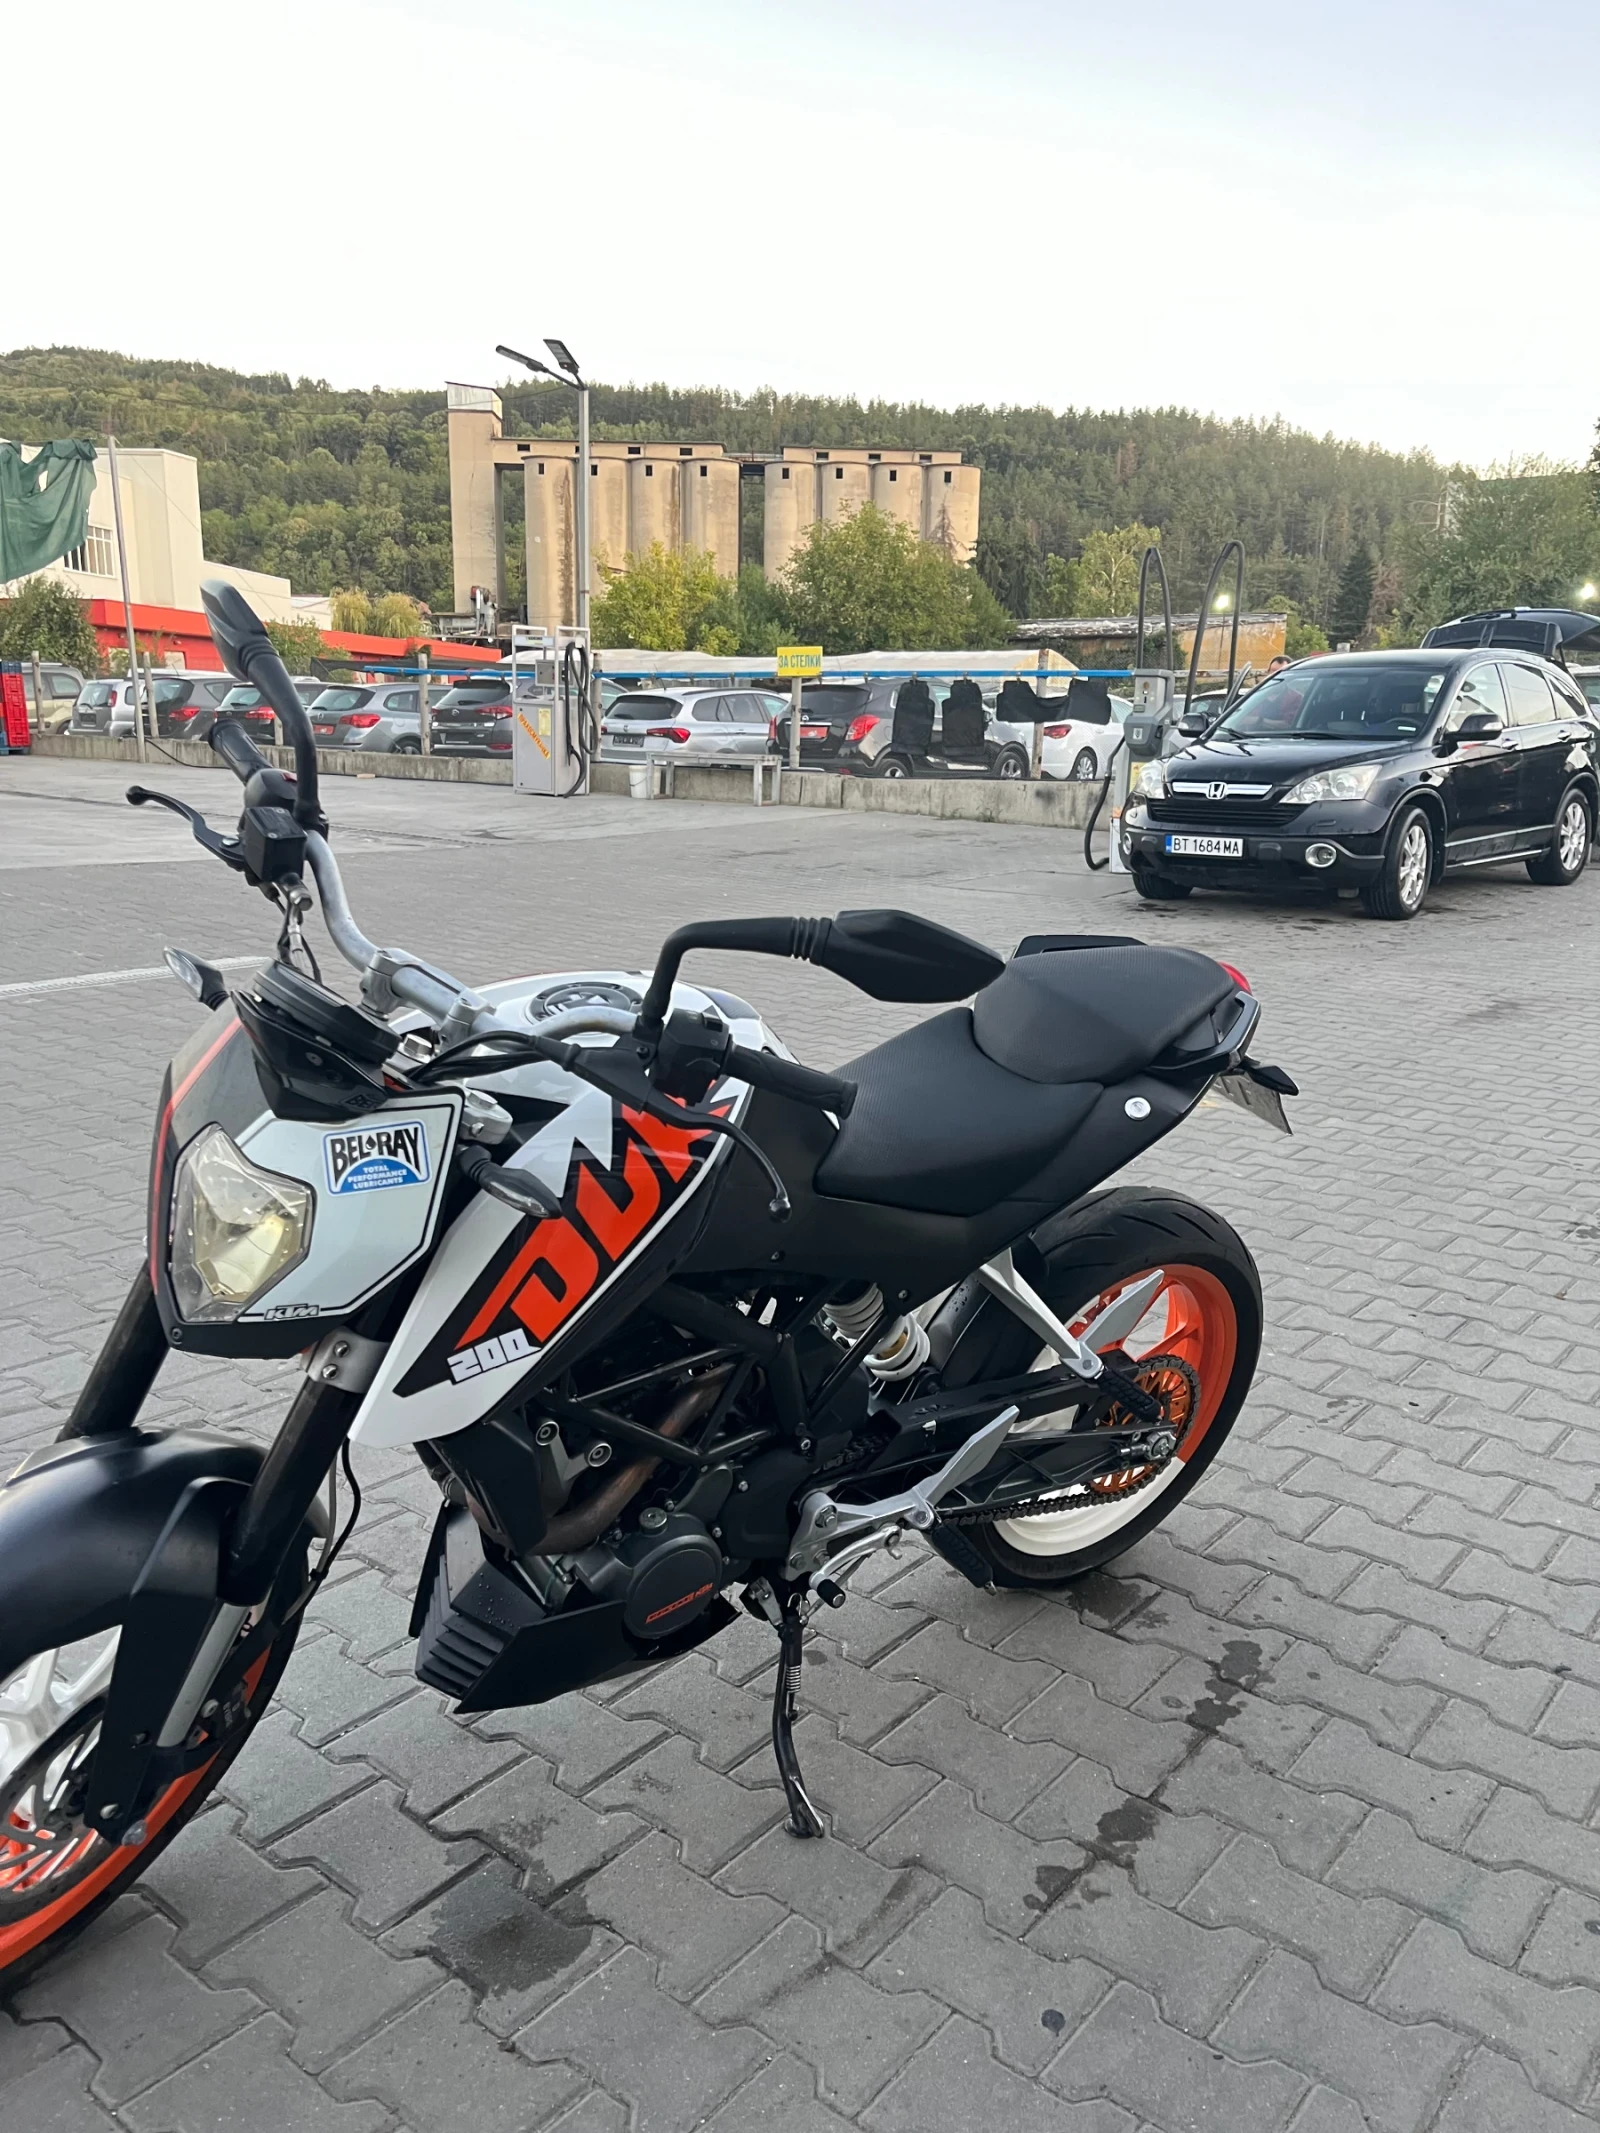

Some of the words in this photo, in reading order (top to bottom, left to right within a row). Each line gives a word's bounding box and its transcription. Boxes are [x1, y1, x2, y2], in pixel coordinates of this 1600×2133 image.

[779, 655, 789, 668] ЗА
[1174, 838, 1189, 851] BT
[1193, 839, 1220, 853] 1684
[1223, 840, 1239, 854] MA
[347, 1169, 408, 1183] PERFORMANCE
[362, 1165, 389, 1174] TOTAL
[353, 1177, 403, 1189] LUBRICANTS
[264, 1303, 319, 1320] KTM
[447, 1328, 541, 1382] 200
